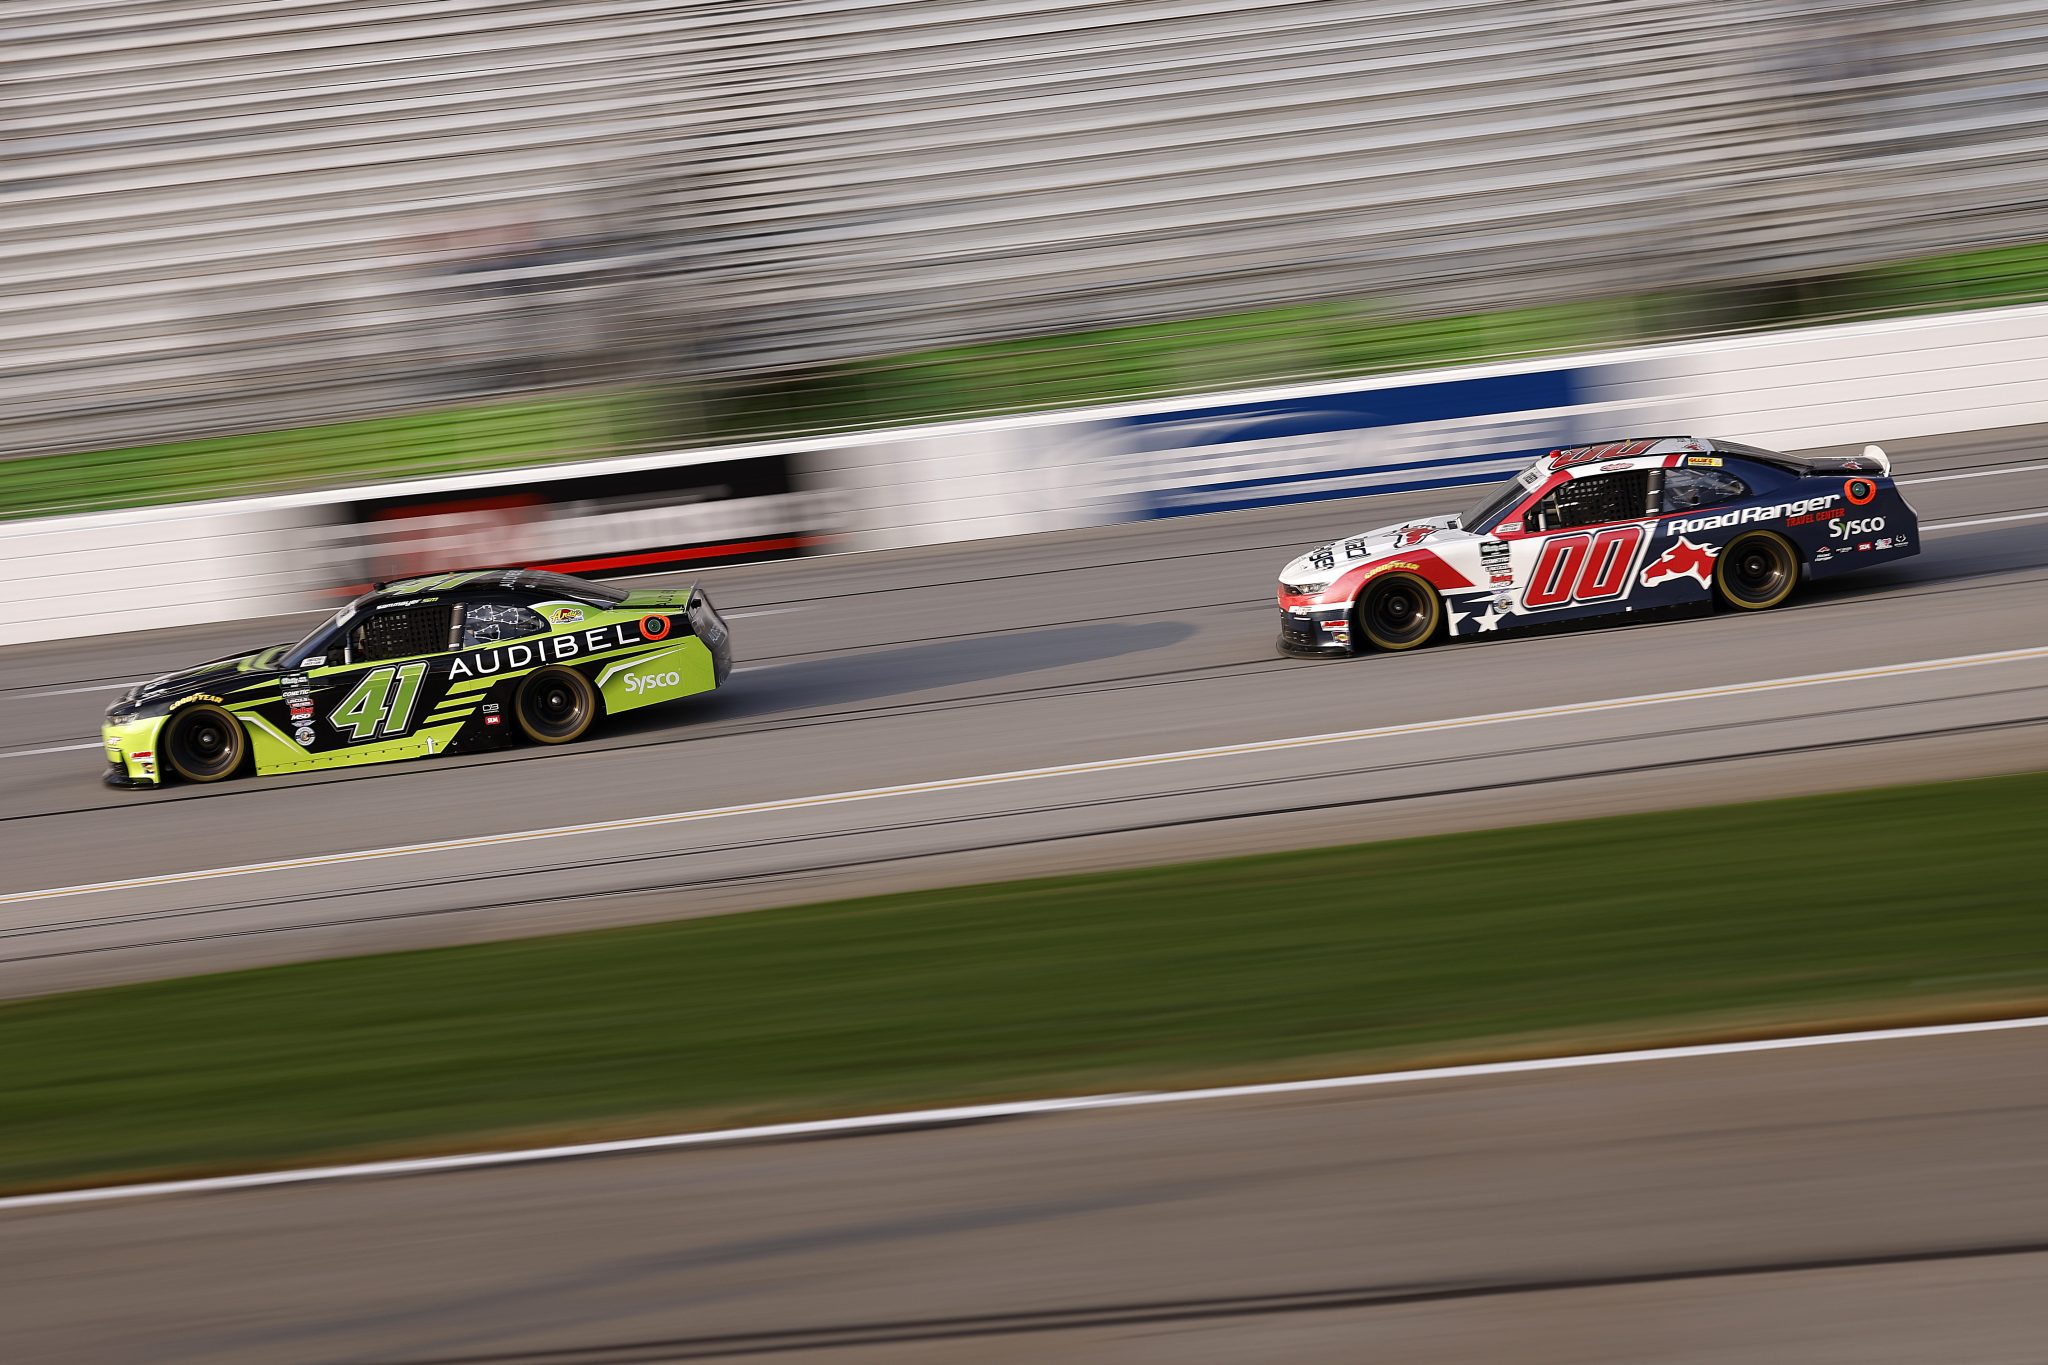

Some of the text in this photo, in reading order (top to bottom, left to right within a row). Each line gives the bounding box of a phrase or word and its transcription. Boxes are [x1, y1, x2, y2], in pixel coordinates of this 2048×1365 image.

[1786, 508, 1845, 527] TRAVEL CENTER
[1828, 516, 1886, 540] Sysco
[1364, 560, 1420, 579] GOODYEAR
[1522, 525, 1644, 609] 00
[448, 624, 641, 680] AUDIBEL
[623, 671, 680, 695] Sysco
[169, 692, 224, 710] GOODYEAR
[328, 662, 428, 740] 41
